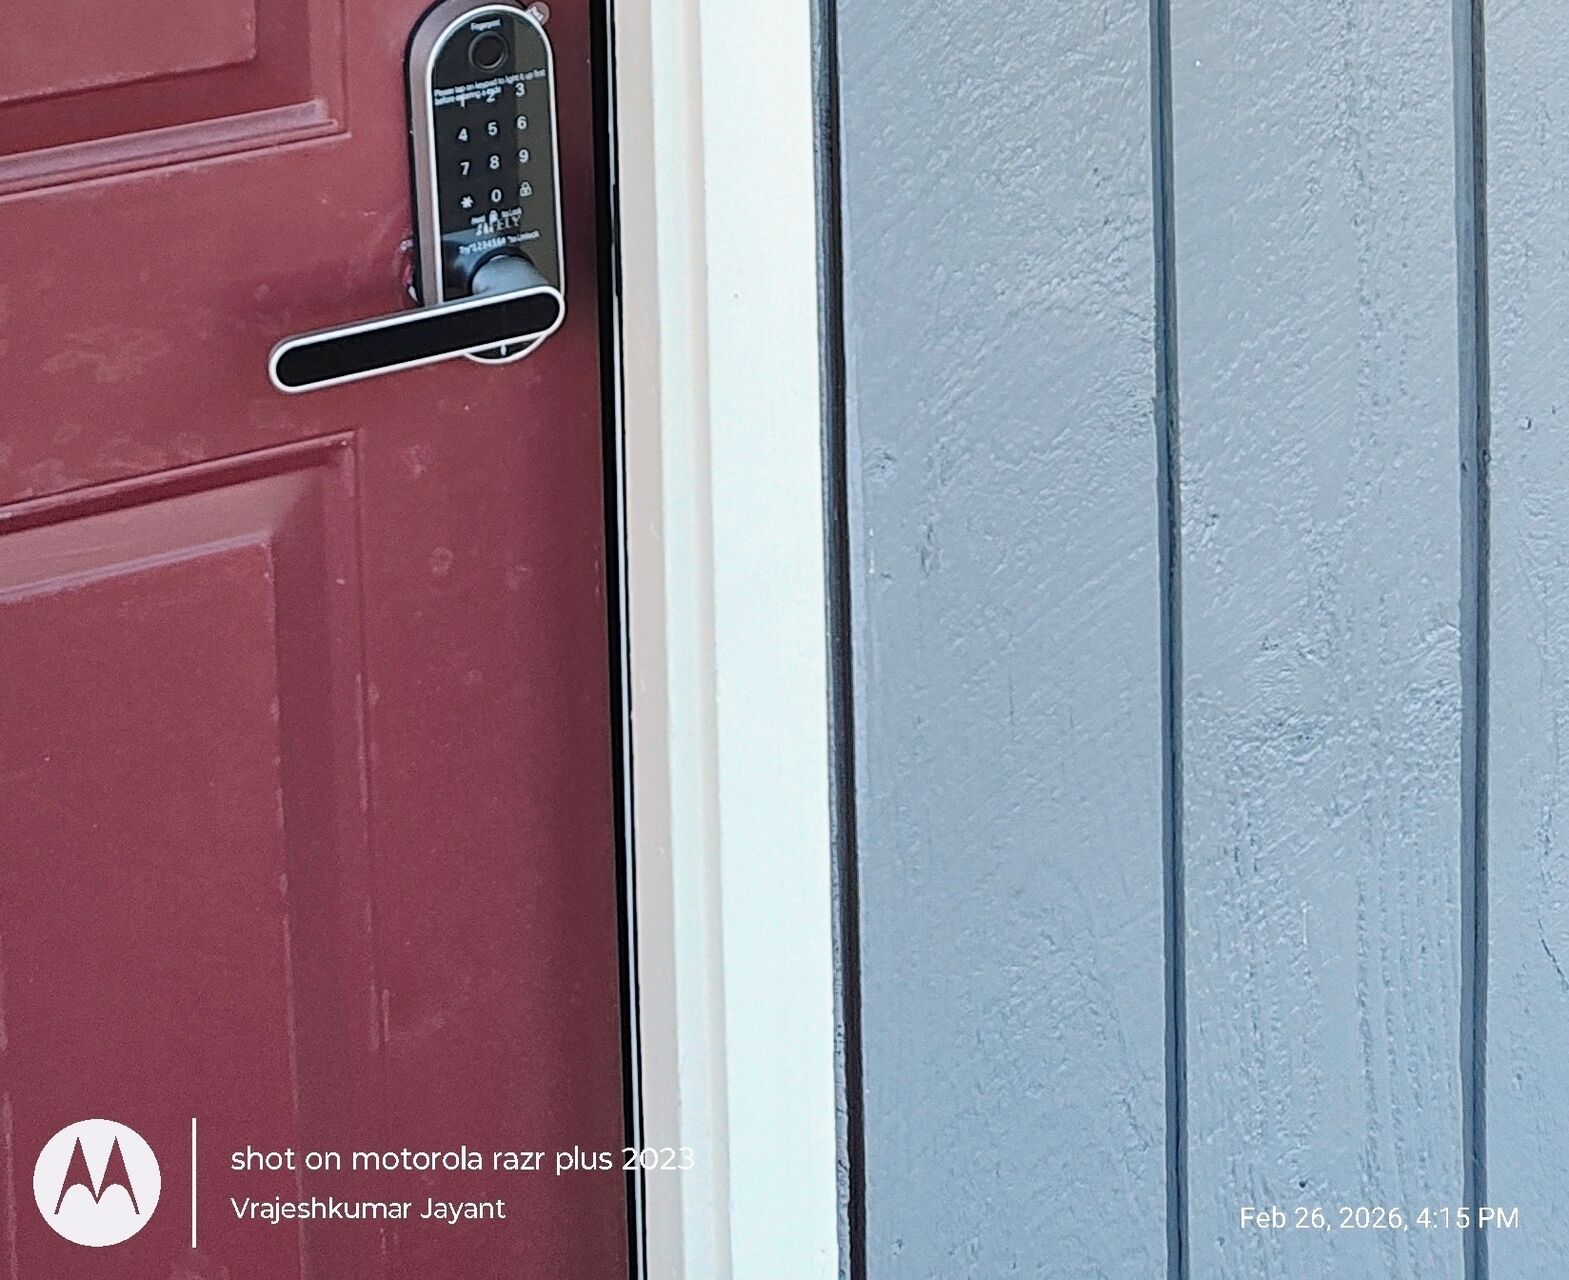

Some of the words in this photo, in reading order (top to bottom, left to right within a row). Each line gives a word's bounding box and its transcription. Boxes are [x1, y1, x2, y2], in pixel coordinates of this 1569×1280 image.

[515, 82, 525, 97] 3
[458, 127, 468, 142] 4
[487, 121, 498, 136] 5
[516, 115, 527, 130] 6
[460, 161, 470, 176] 7
[489, 155, 500, 170] 8
[518, 148, 529, 163] 9
[490, 189, 502, 203] 0
